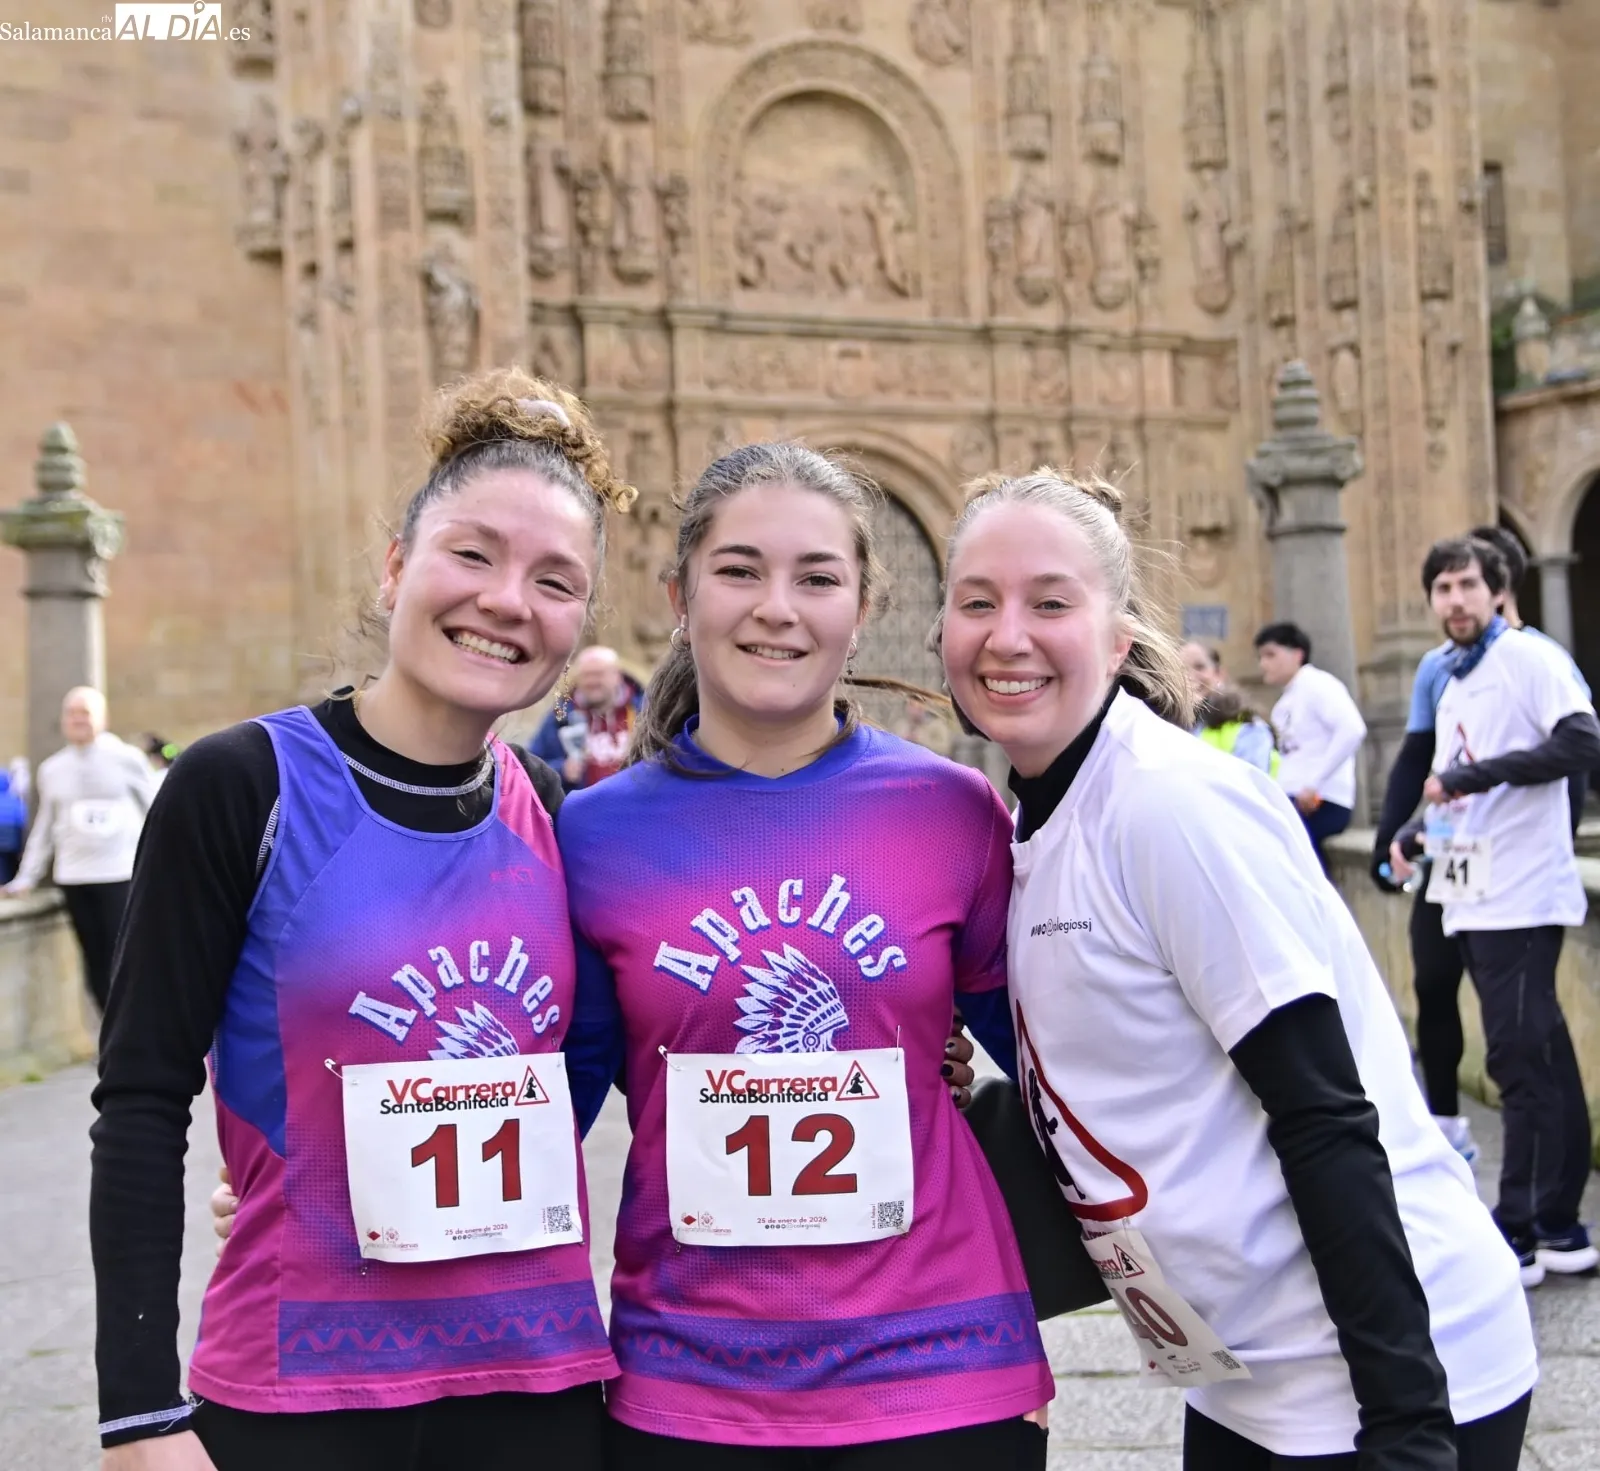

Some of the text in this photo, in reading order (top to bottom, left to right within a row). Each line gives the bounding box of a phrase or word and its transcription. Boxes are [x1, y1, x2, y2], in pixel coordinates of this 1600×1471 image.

[1445, 857, 1468, 886] 41
[653, 873, 907, 995] Apaches
[348, 935, 560, 1045] Apaches
[380, 1092, 509, 1115] SantaBonifacia
[699, 1086, 829, 1104] SantaBonifacia
[411, 1118, 522, 1209] 11
[725, 1113, 857, 1196] 12
[1109, 1286, 1188, 1349] 40
